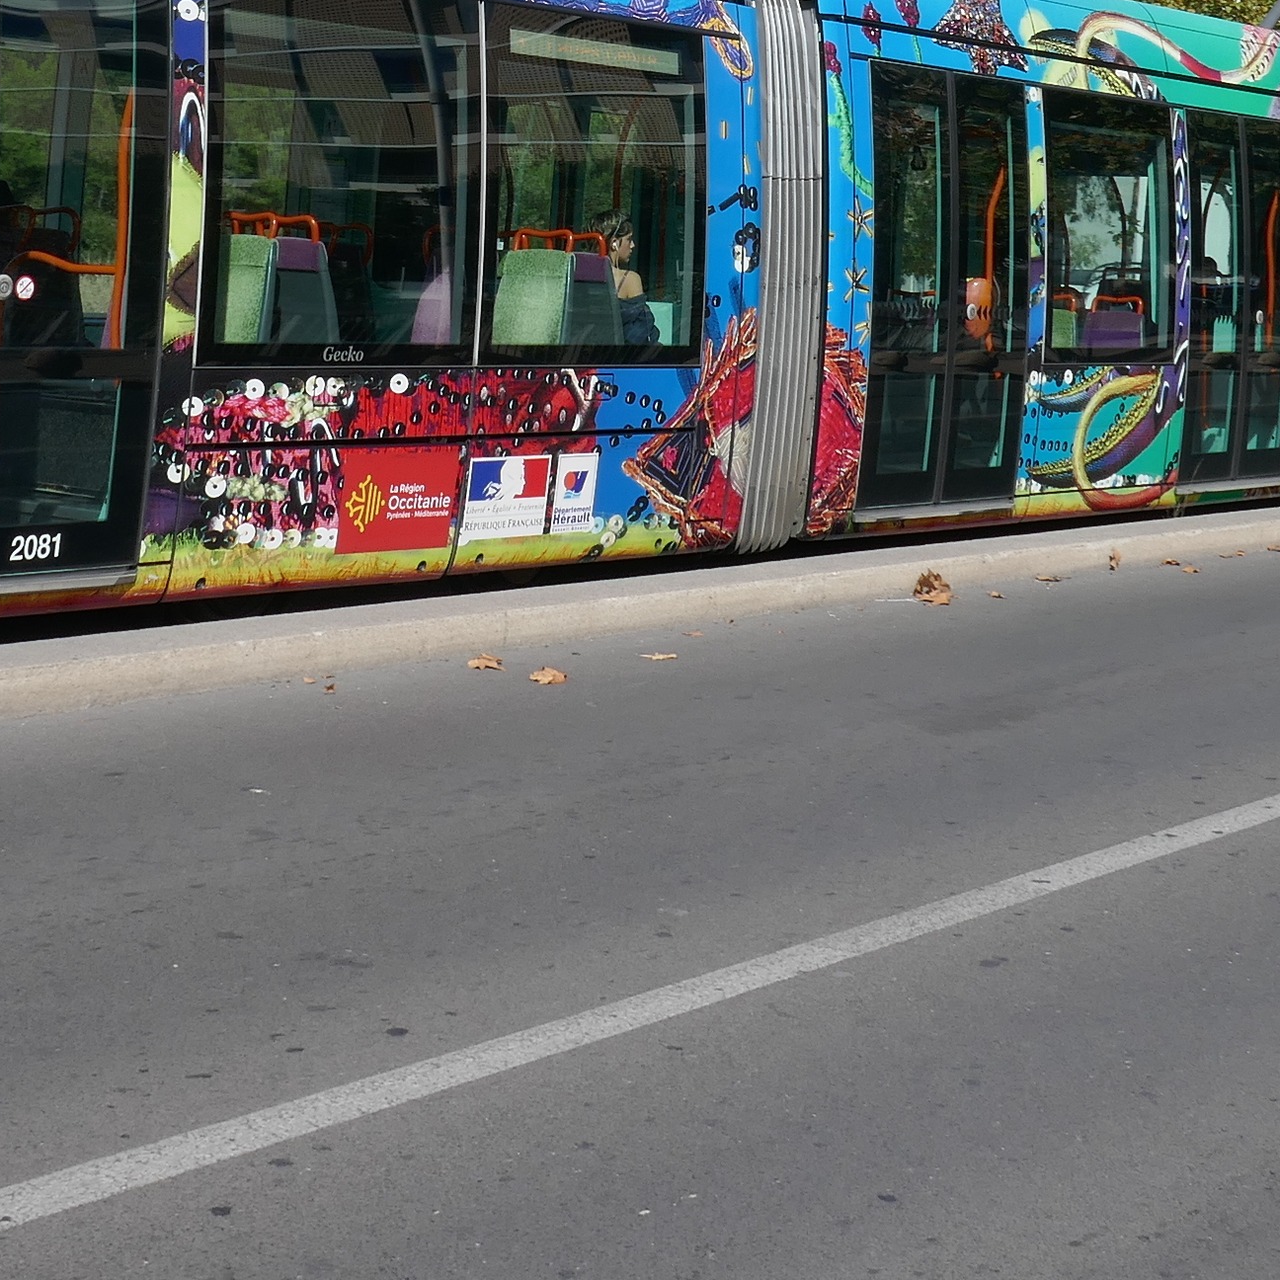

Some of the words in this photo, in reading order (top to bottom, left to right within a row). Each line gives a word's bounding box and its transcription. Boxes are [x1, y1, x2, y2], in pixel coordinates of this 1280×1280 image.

[323, 346, 364, 362] Gecko
[390, 484, 398, 494] La
[400, 483, 425, 495] Région
[388, 492, 451, 510] Occitanie
[464, 520, 507, 532] RÉPUBLIQUE
[508, 518, 543, 528] FRANÇAISE
[553, 512, 590, 525] Hérault
[9, 532, 61, 561] 2081
